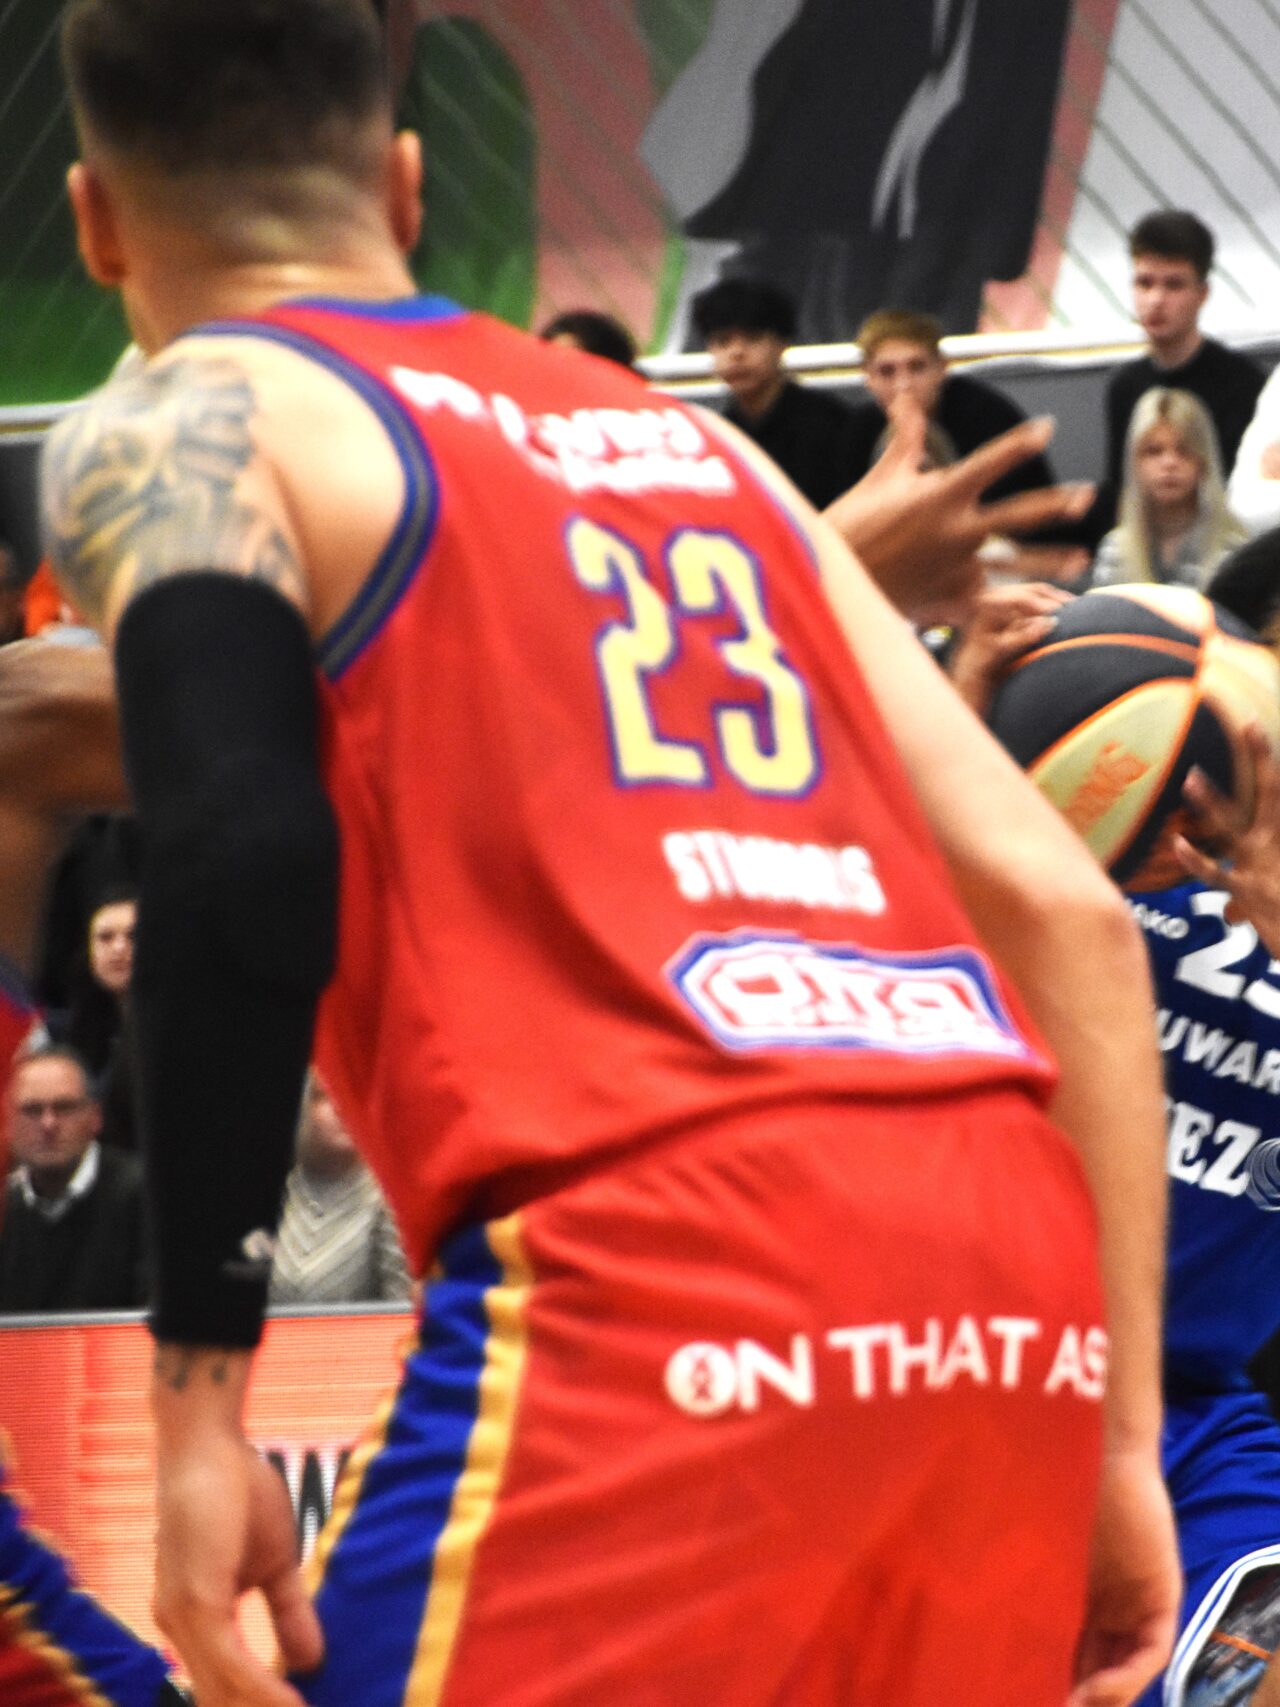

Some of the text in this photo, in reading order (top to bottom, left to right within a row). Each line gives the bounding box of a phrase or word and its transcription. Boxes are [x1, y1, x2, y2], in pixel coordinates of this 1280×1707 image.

[564, 512, 822, 802] 23
[665, 1334, 813, 1417] ON
[827, 1315, 1039, 1399] THAT
